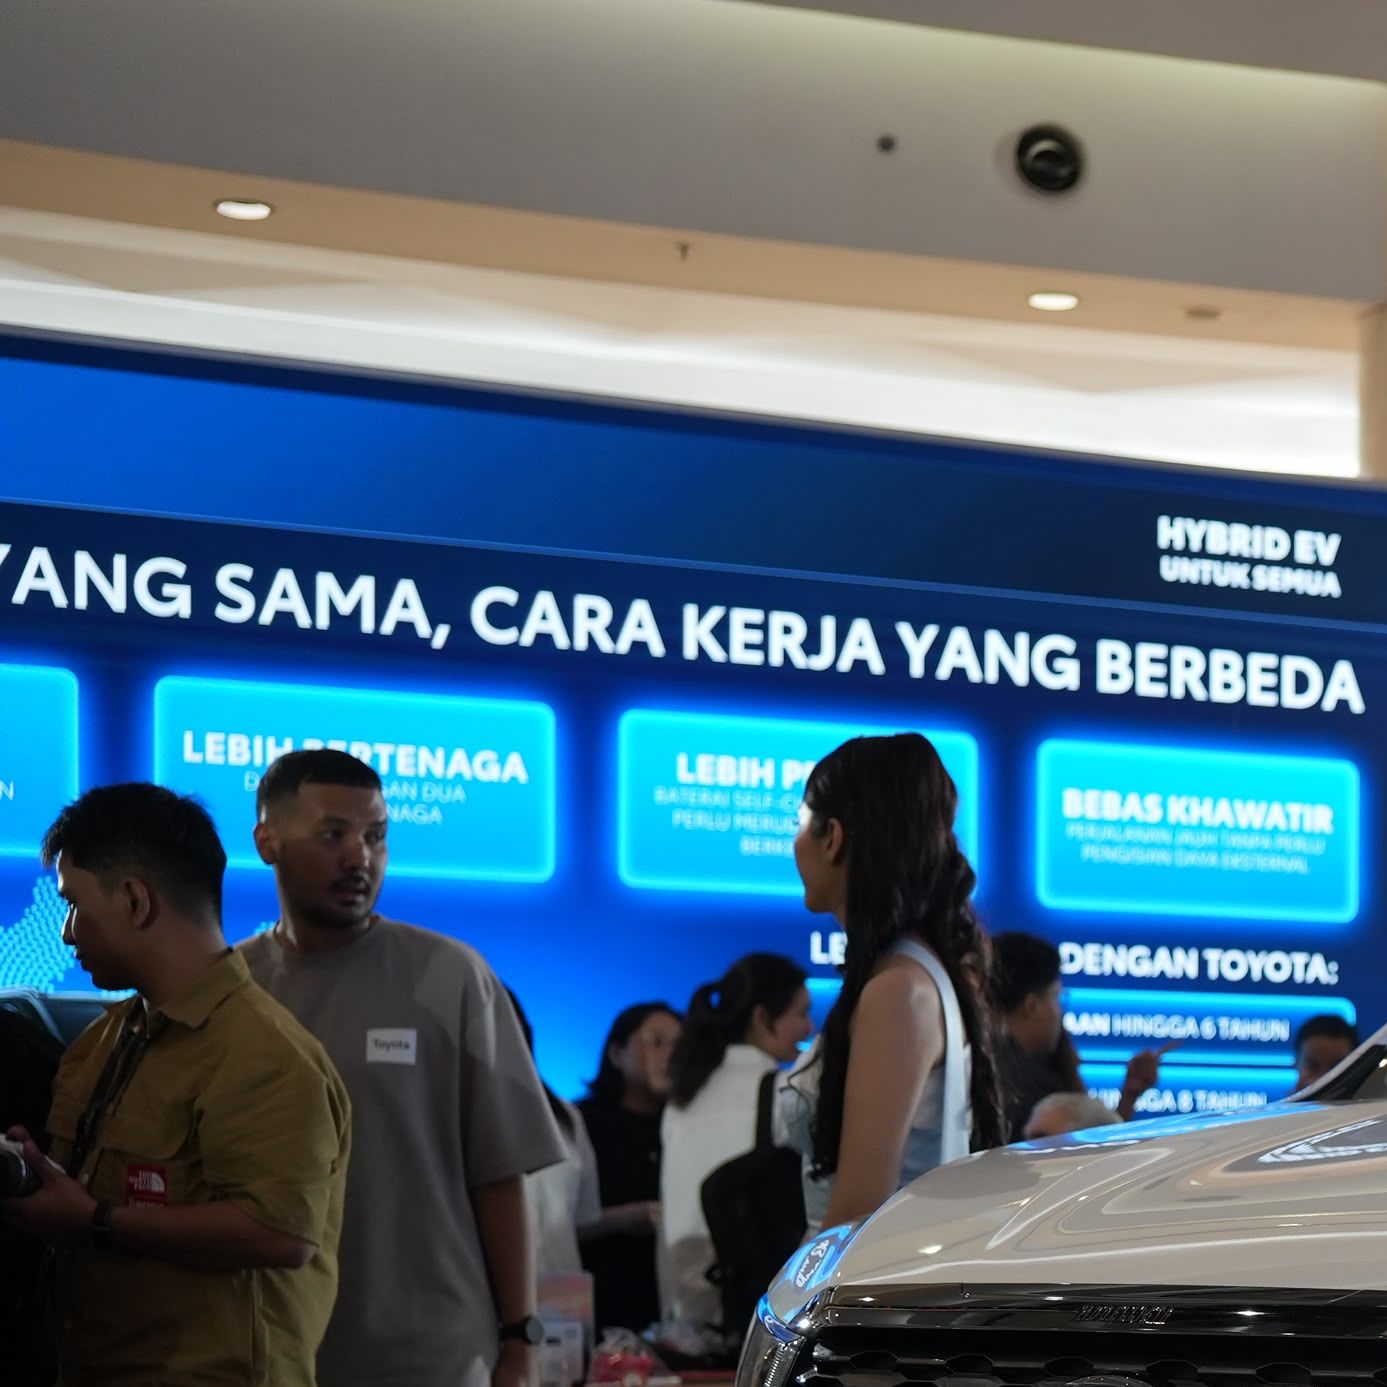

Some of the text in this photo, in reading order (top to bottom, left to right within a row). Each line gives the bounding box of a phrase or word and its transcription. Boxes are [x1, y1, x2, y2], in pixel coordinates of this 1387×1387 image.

[1157, 515, 1342, 566] HYBRID EV
[1159, 555, 1342, 598] UNTUK SEMUA
[0, 543, 1366, 714] ANG SAMA, CARA KERJA YANG BERBEDA
[183, 730, 294, 768] LEBIH
[676, 752, 776, 789] LEBIH
[1062, 788, 1334, 834] BEBAS KHAWATIR
[1059, 942, 1199, 978] DENGAN
[1202, 948, 1339, 985] TOYOTA:
[1111, 1015, 1200, 1040] HINGGA
[1200, 1018, 1217, 1040] 6
[1215, 1016, 1290, 1041] TAHUN
